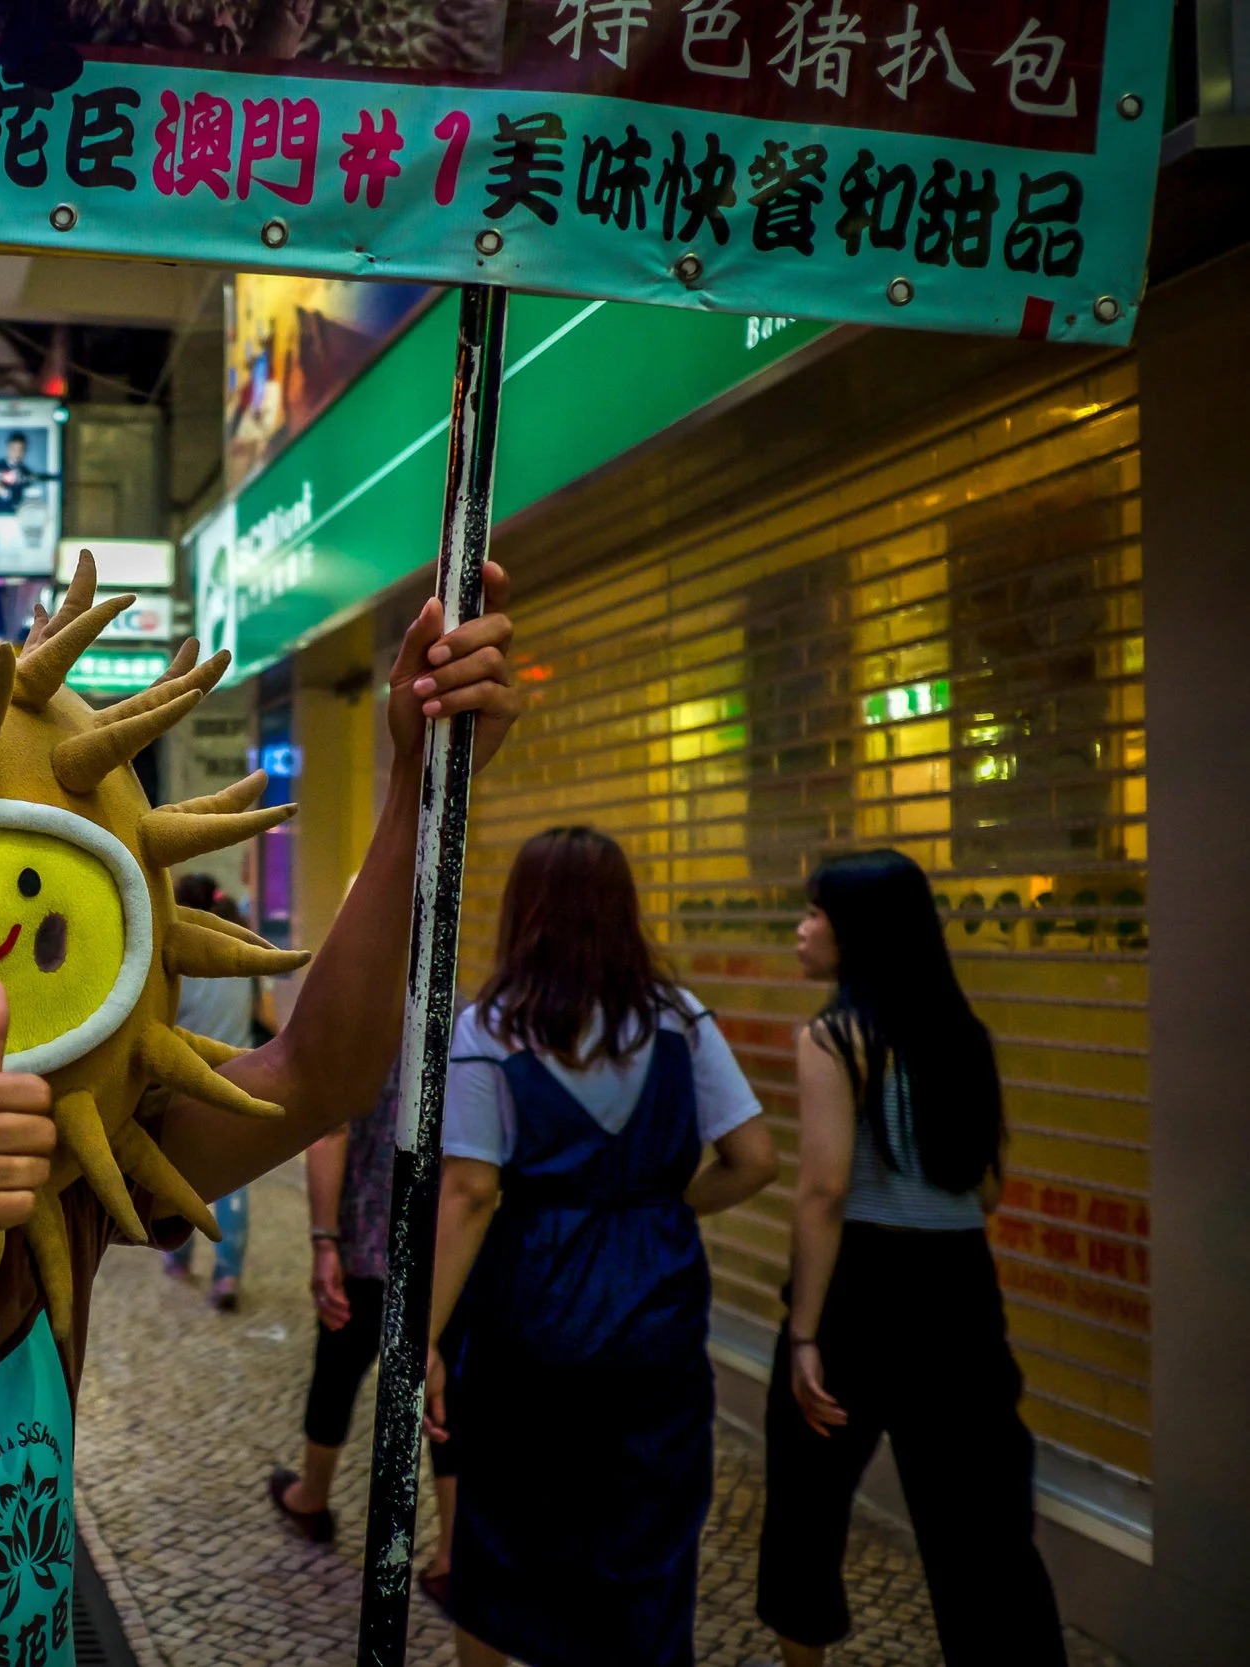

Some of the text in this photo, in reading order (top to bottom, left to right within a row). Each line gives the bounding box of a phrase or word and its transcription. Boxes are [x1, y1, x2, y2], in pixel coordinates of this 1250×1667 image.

[547, 0, 1078, 117] 特色猪扒包
